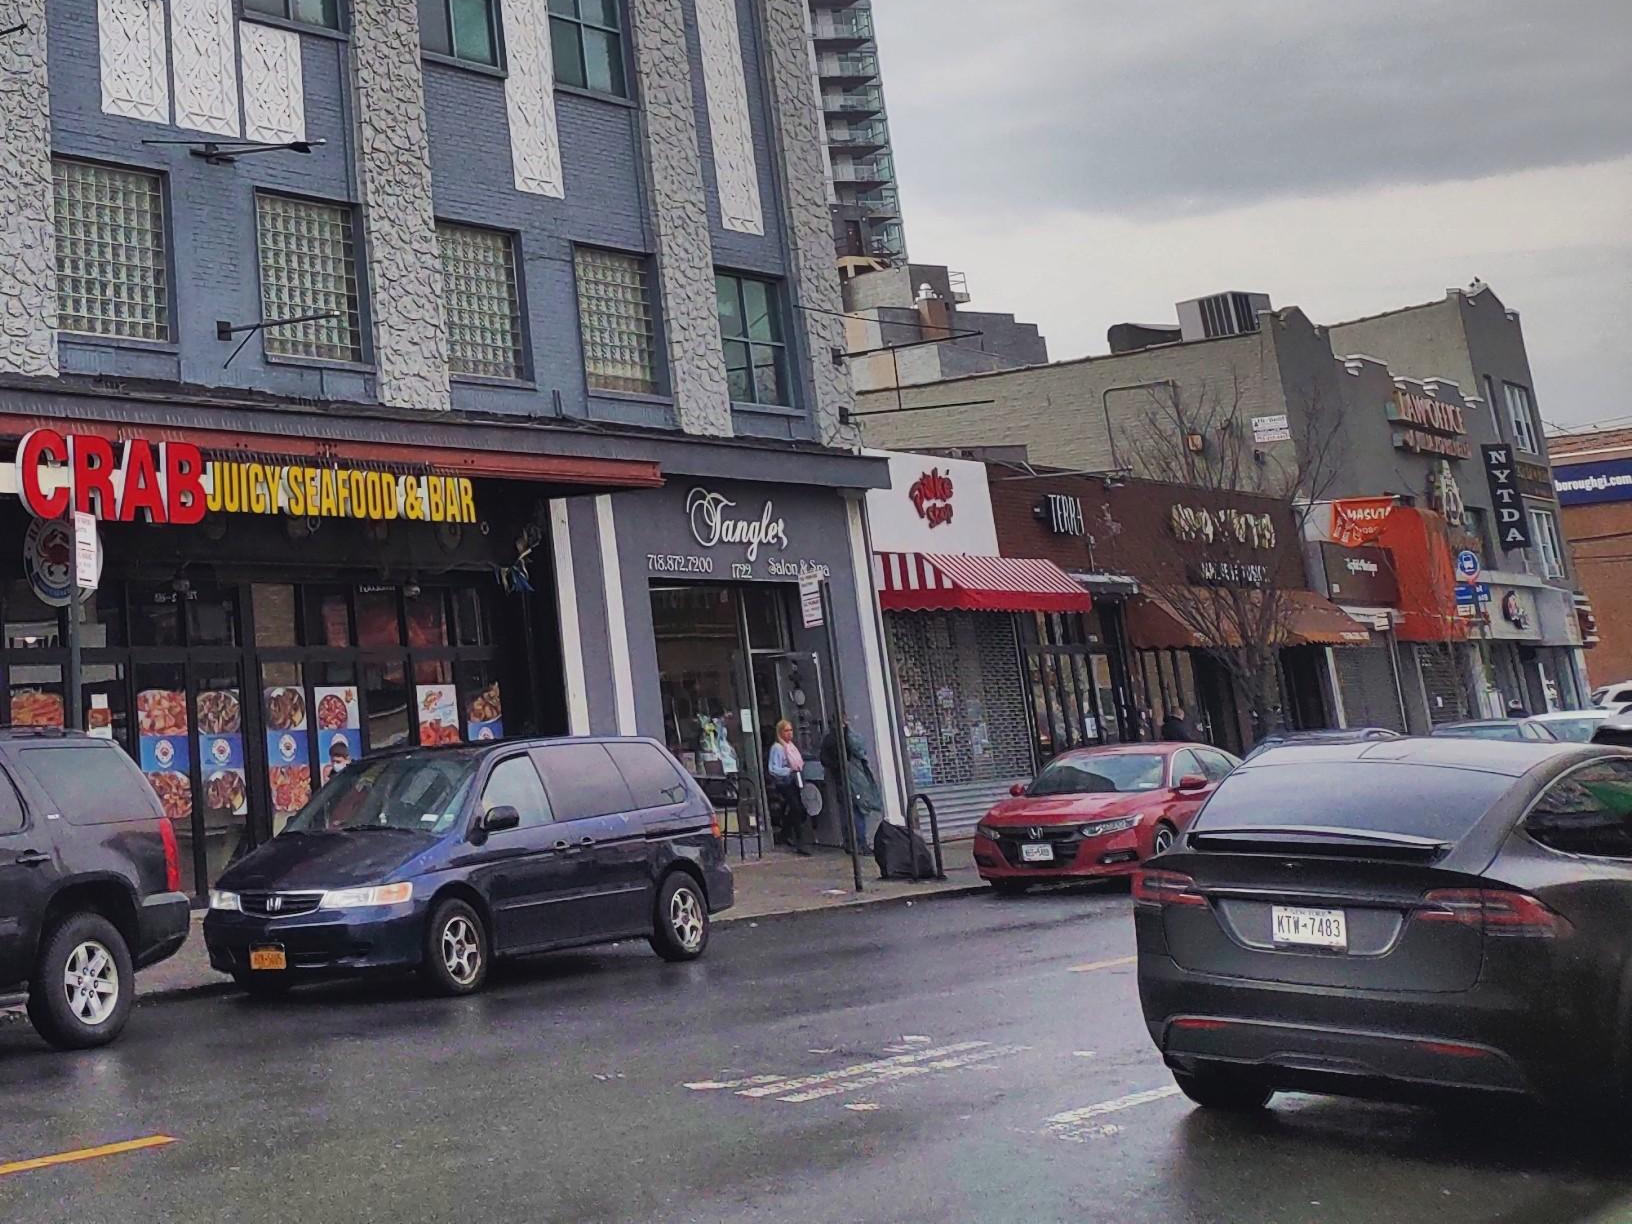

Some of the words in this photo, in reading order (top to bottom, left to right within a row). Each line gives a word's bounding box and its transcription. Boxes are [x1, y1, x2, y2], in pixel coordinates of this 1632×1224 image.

[17, 428, 208, 525] CRAB
[205, 460, 282, 515] JUICY
[282, 465, 397, 520] SEAFOOD
[402, 475, 424, 520] &
[423, 475, 477, 523] BAR
[1488, 450, 1525, 542] NYTDA
[687, 487, 788, 561] Tangles
[1048, 494, 1085, 536] TERRA
[647, 554, 713, 573] 718.872.7200
[732, 563, 753, 579] 1722
[769, 558, 798, 576] Salon
